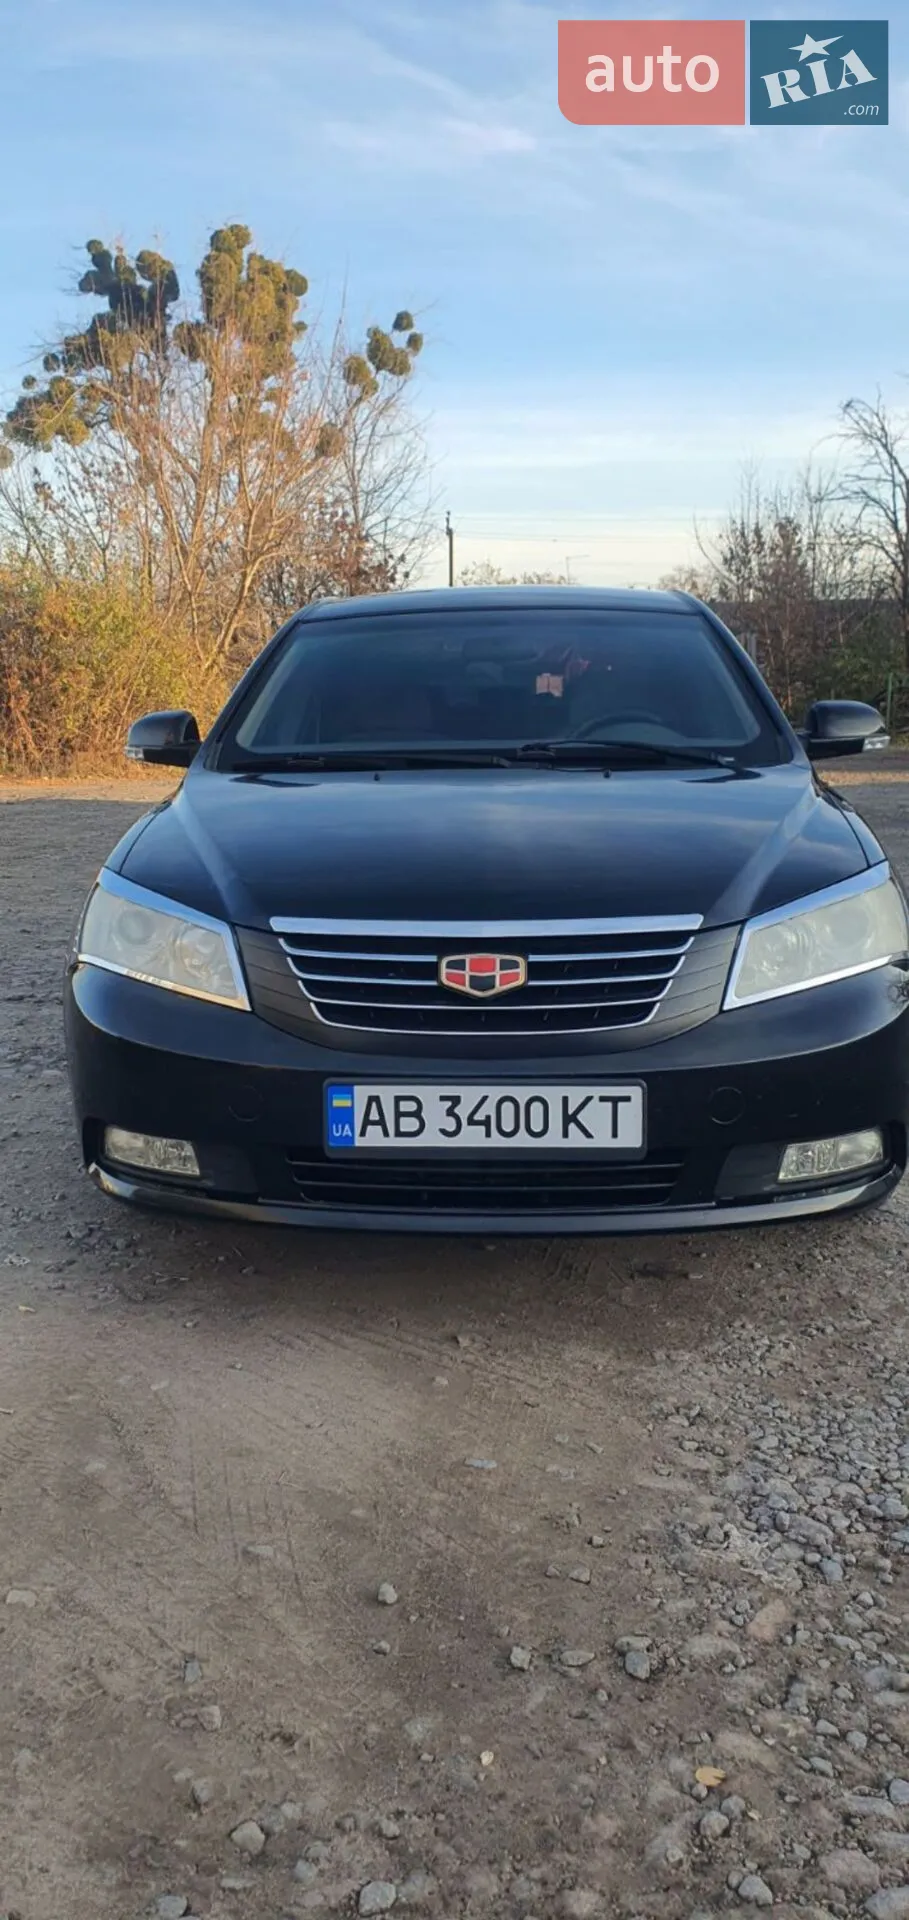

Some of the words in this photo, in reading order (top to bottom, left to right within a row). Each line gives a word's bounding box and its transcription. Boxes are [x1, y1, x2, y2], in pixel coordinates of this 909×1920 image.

[332, 1124, 352, 1137] UA
[359, 1095, 426, 1138] AB
[438, 1095, 550, 1139] 3400
[561, 1095, 632, 1139] KT
